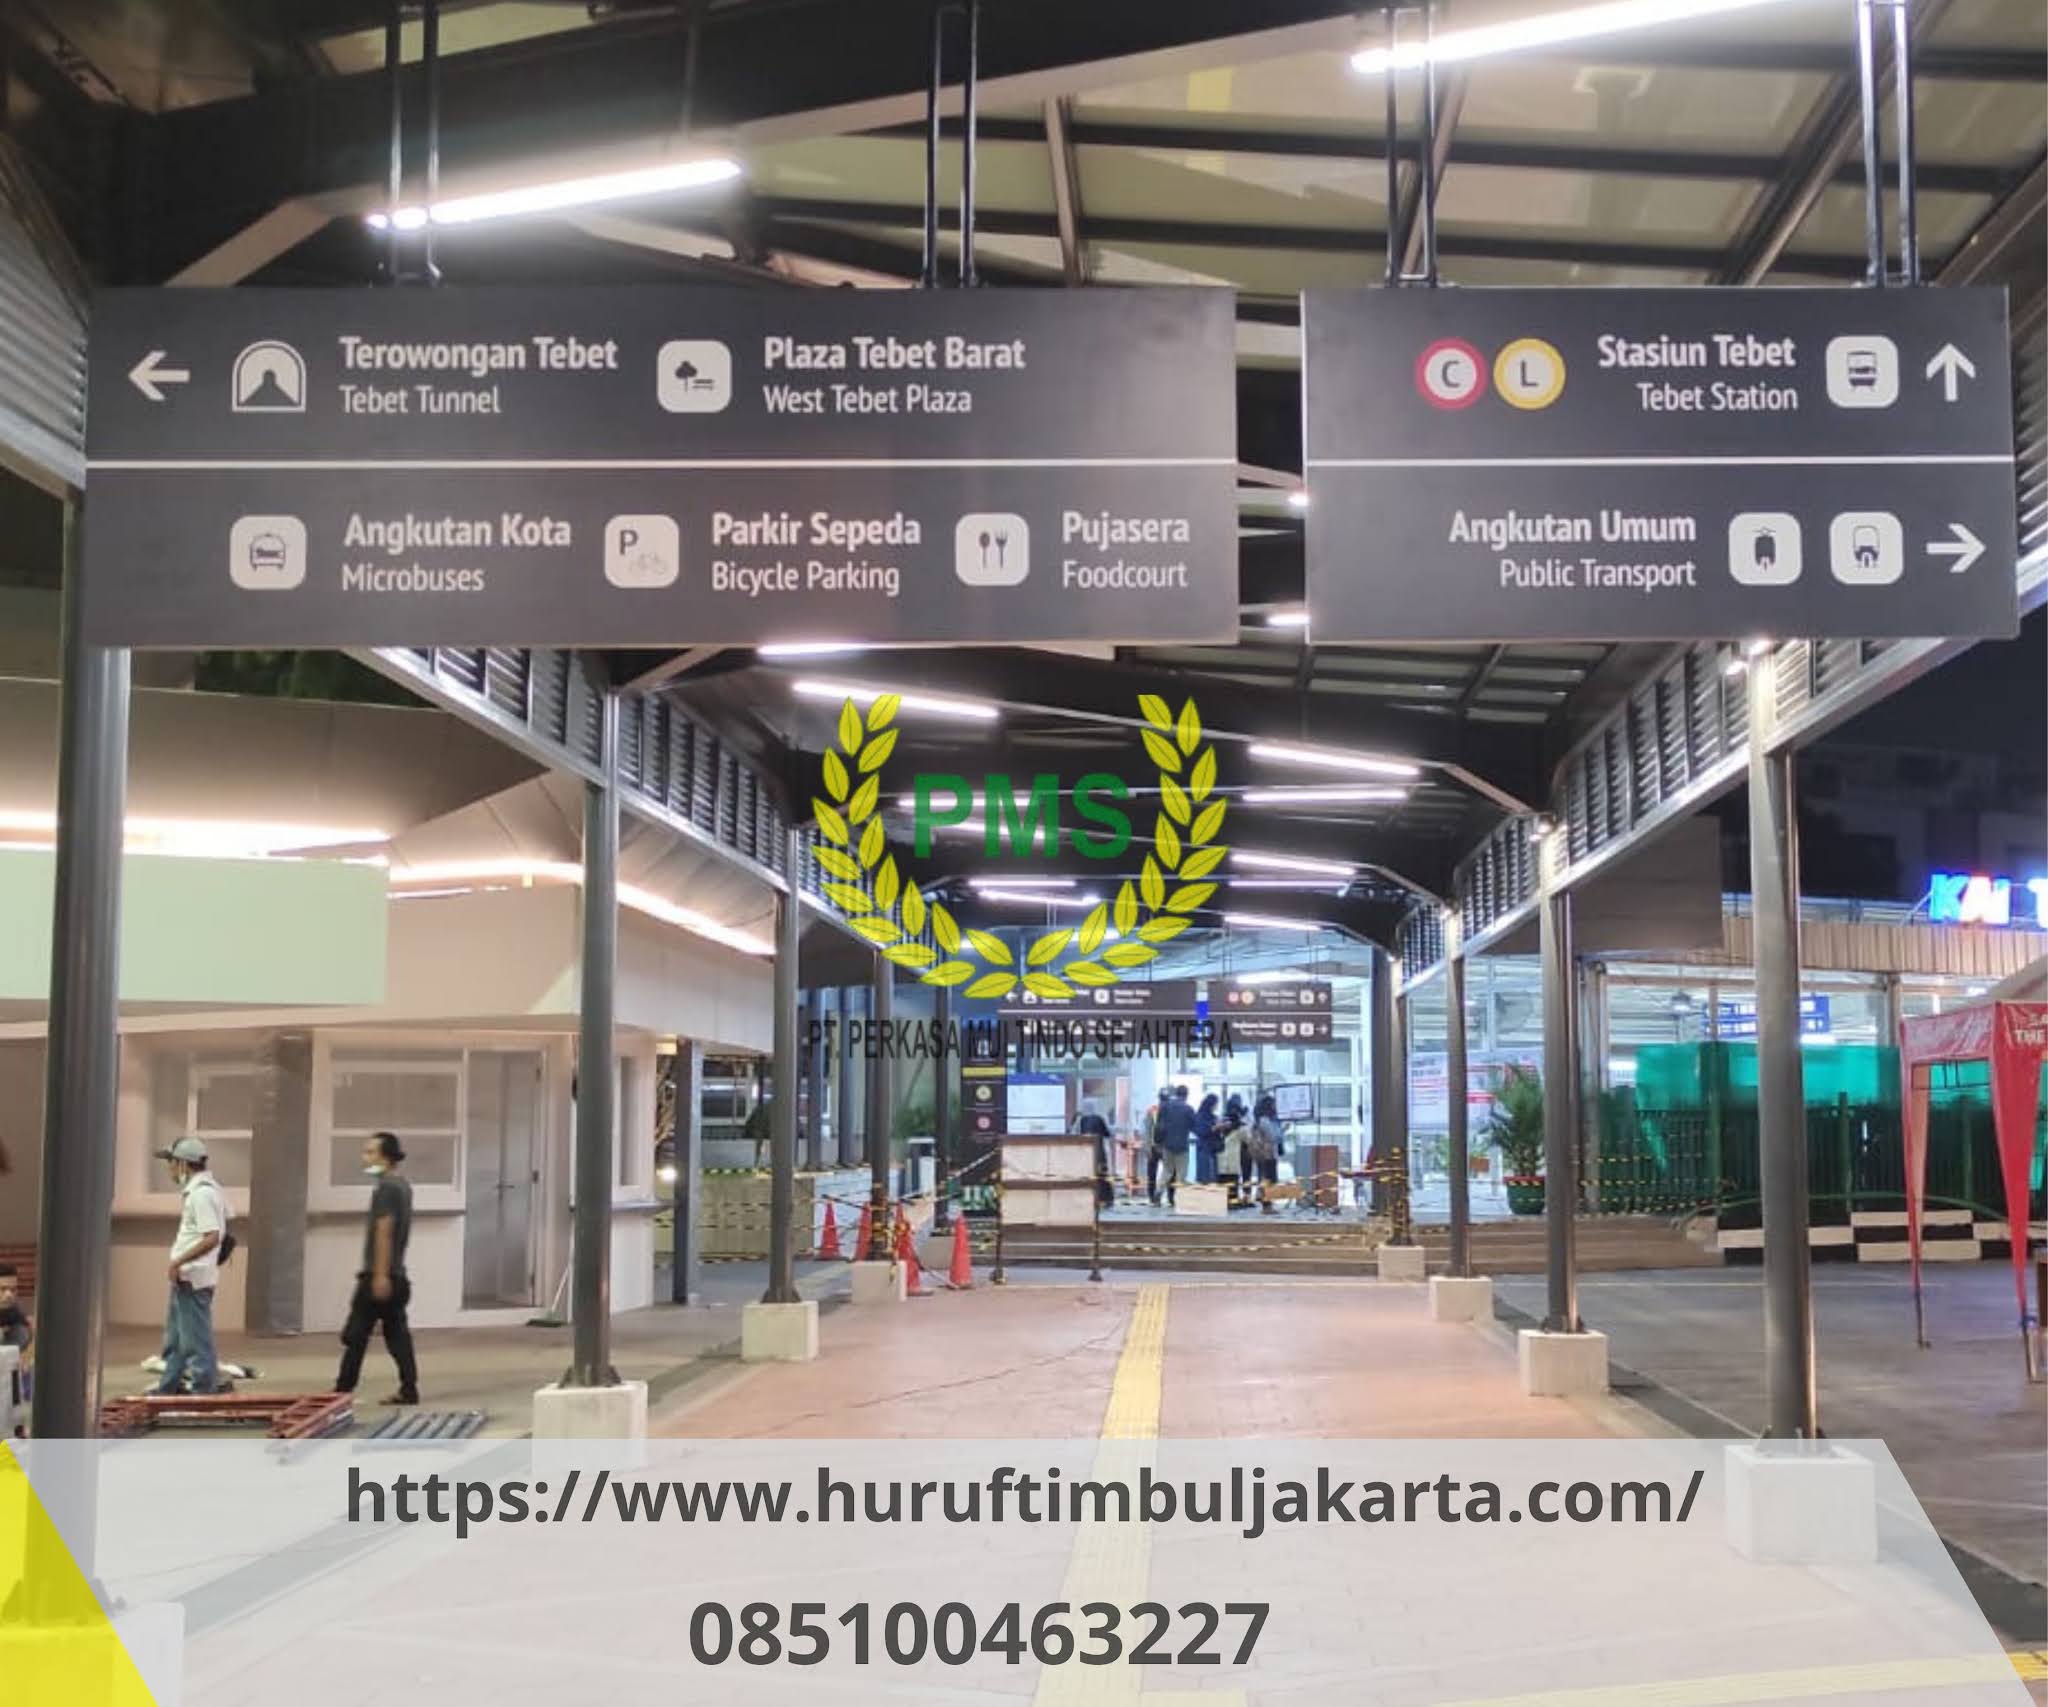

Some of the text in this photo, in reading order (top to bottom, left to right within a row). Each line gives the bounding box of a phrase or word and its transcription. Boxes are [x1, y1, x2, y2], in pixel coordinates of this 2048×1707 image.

[338, 336, 617, 376] Terowongan Tebet
[764, 336, 1026, 369] Plaza Tebet Barat
[1597, 335, 1797, 368] Stasiun Tebet
[1440, 361, 1461, 389] C
[1519, 361, 1539, 387] L
[339, 385, 501, 414] Tebet Tunnel
[764, 385, 973, 413] West Tebet Plaza
[1637, 383, 1798, 411] Tebet Station
[343, 515, 571, 555] Angkutan Kota
[619, 529, 638, 556] P
[712, 513, 921, 553] Parkir Sepeda
[1063, 512, 1190, 552] Pujasera
[1449, 511, 1696, 550] Angkutan Umum
[341, 565, 485, 593] Microbuses
[712, 563, 901, 597] Bicycle Parking
[1063, 560, 1188, 590] Foodcourt
[1500, 560, 1697, 592] Public Transport
